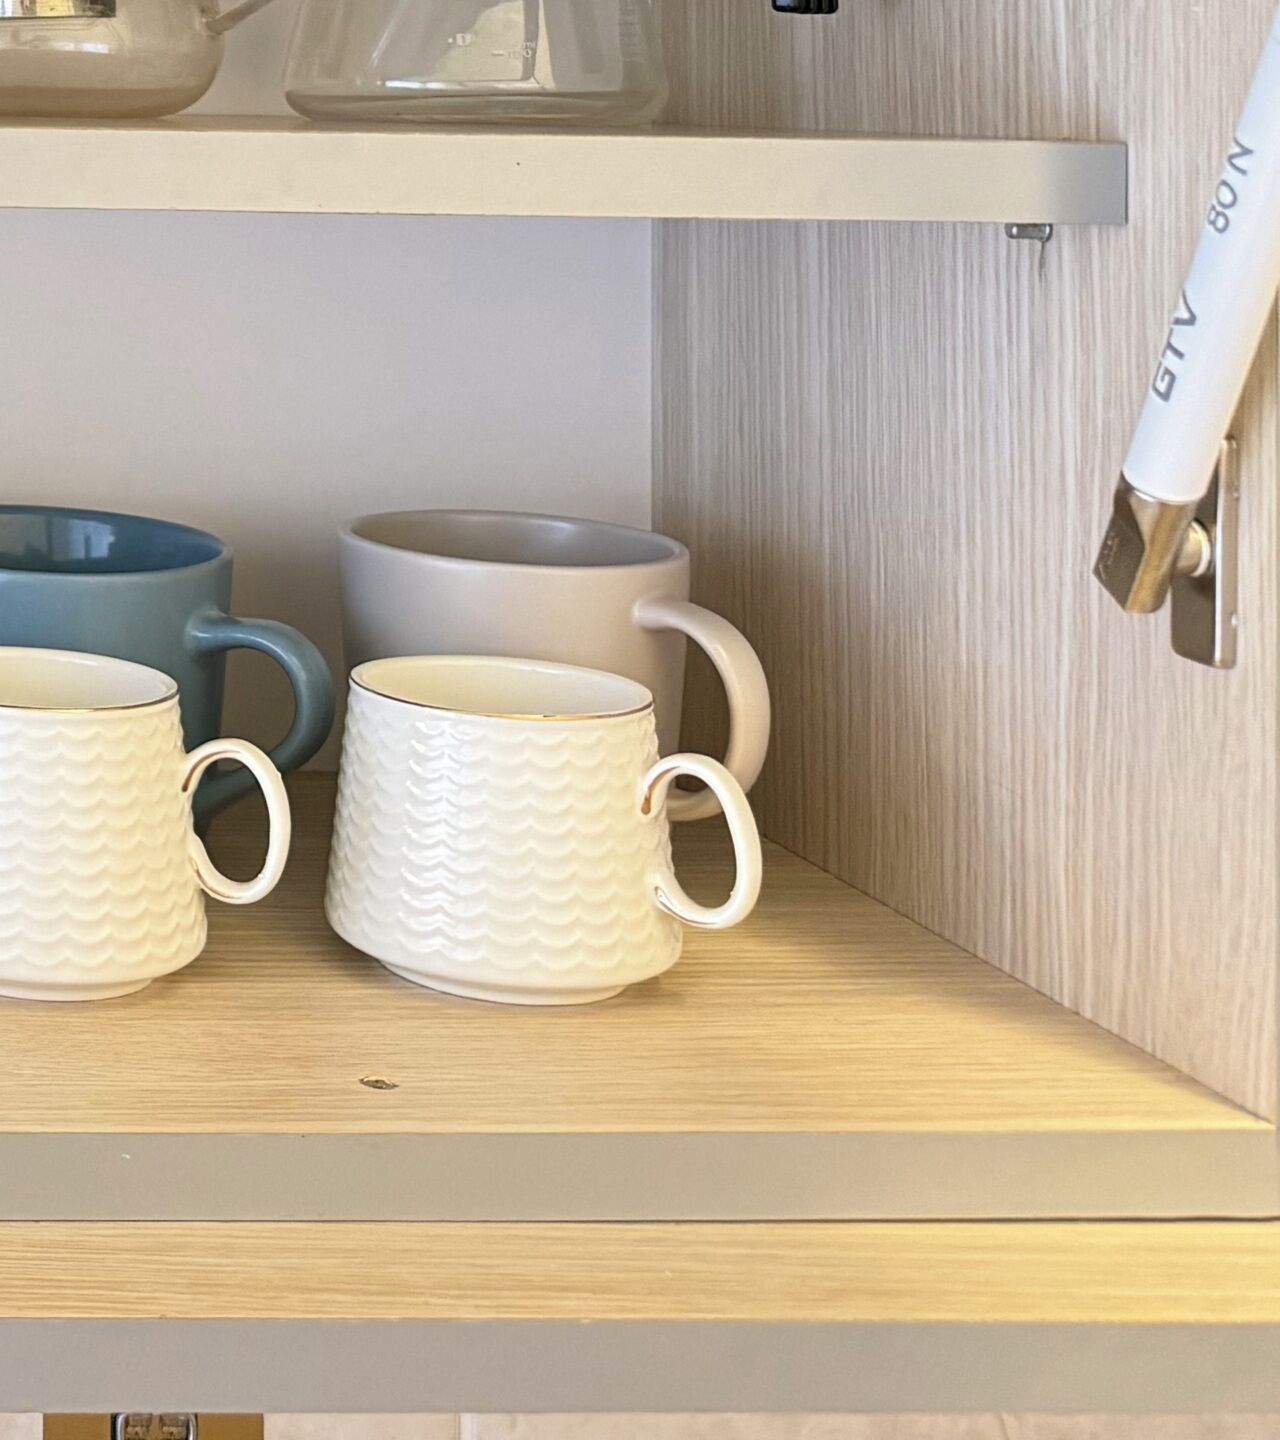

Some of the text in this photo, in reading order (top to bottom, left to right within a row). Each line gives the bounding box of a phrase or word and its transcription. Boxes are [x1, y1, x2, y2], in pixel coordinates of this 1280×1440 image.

[1151, 136, 1254, 403] GTV 80 N
